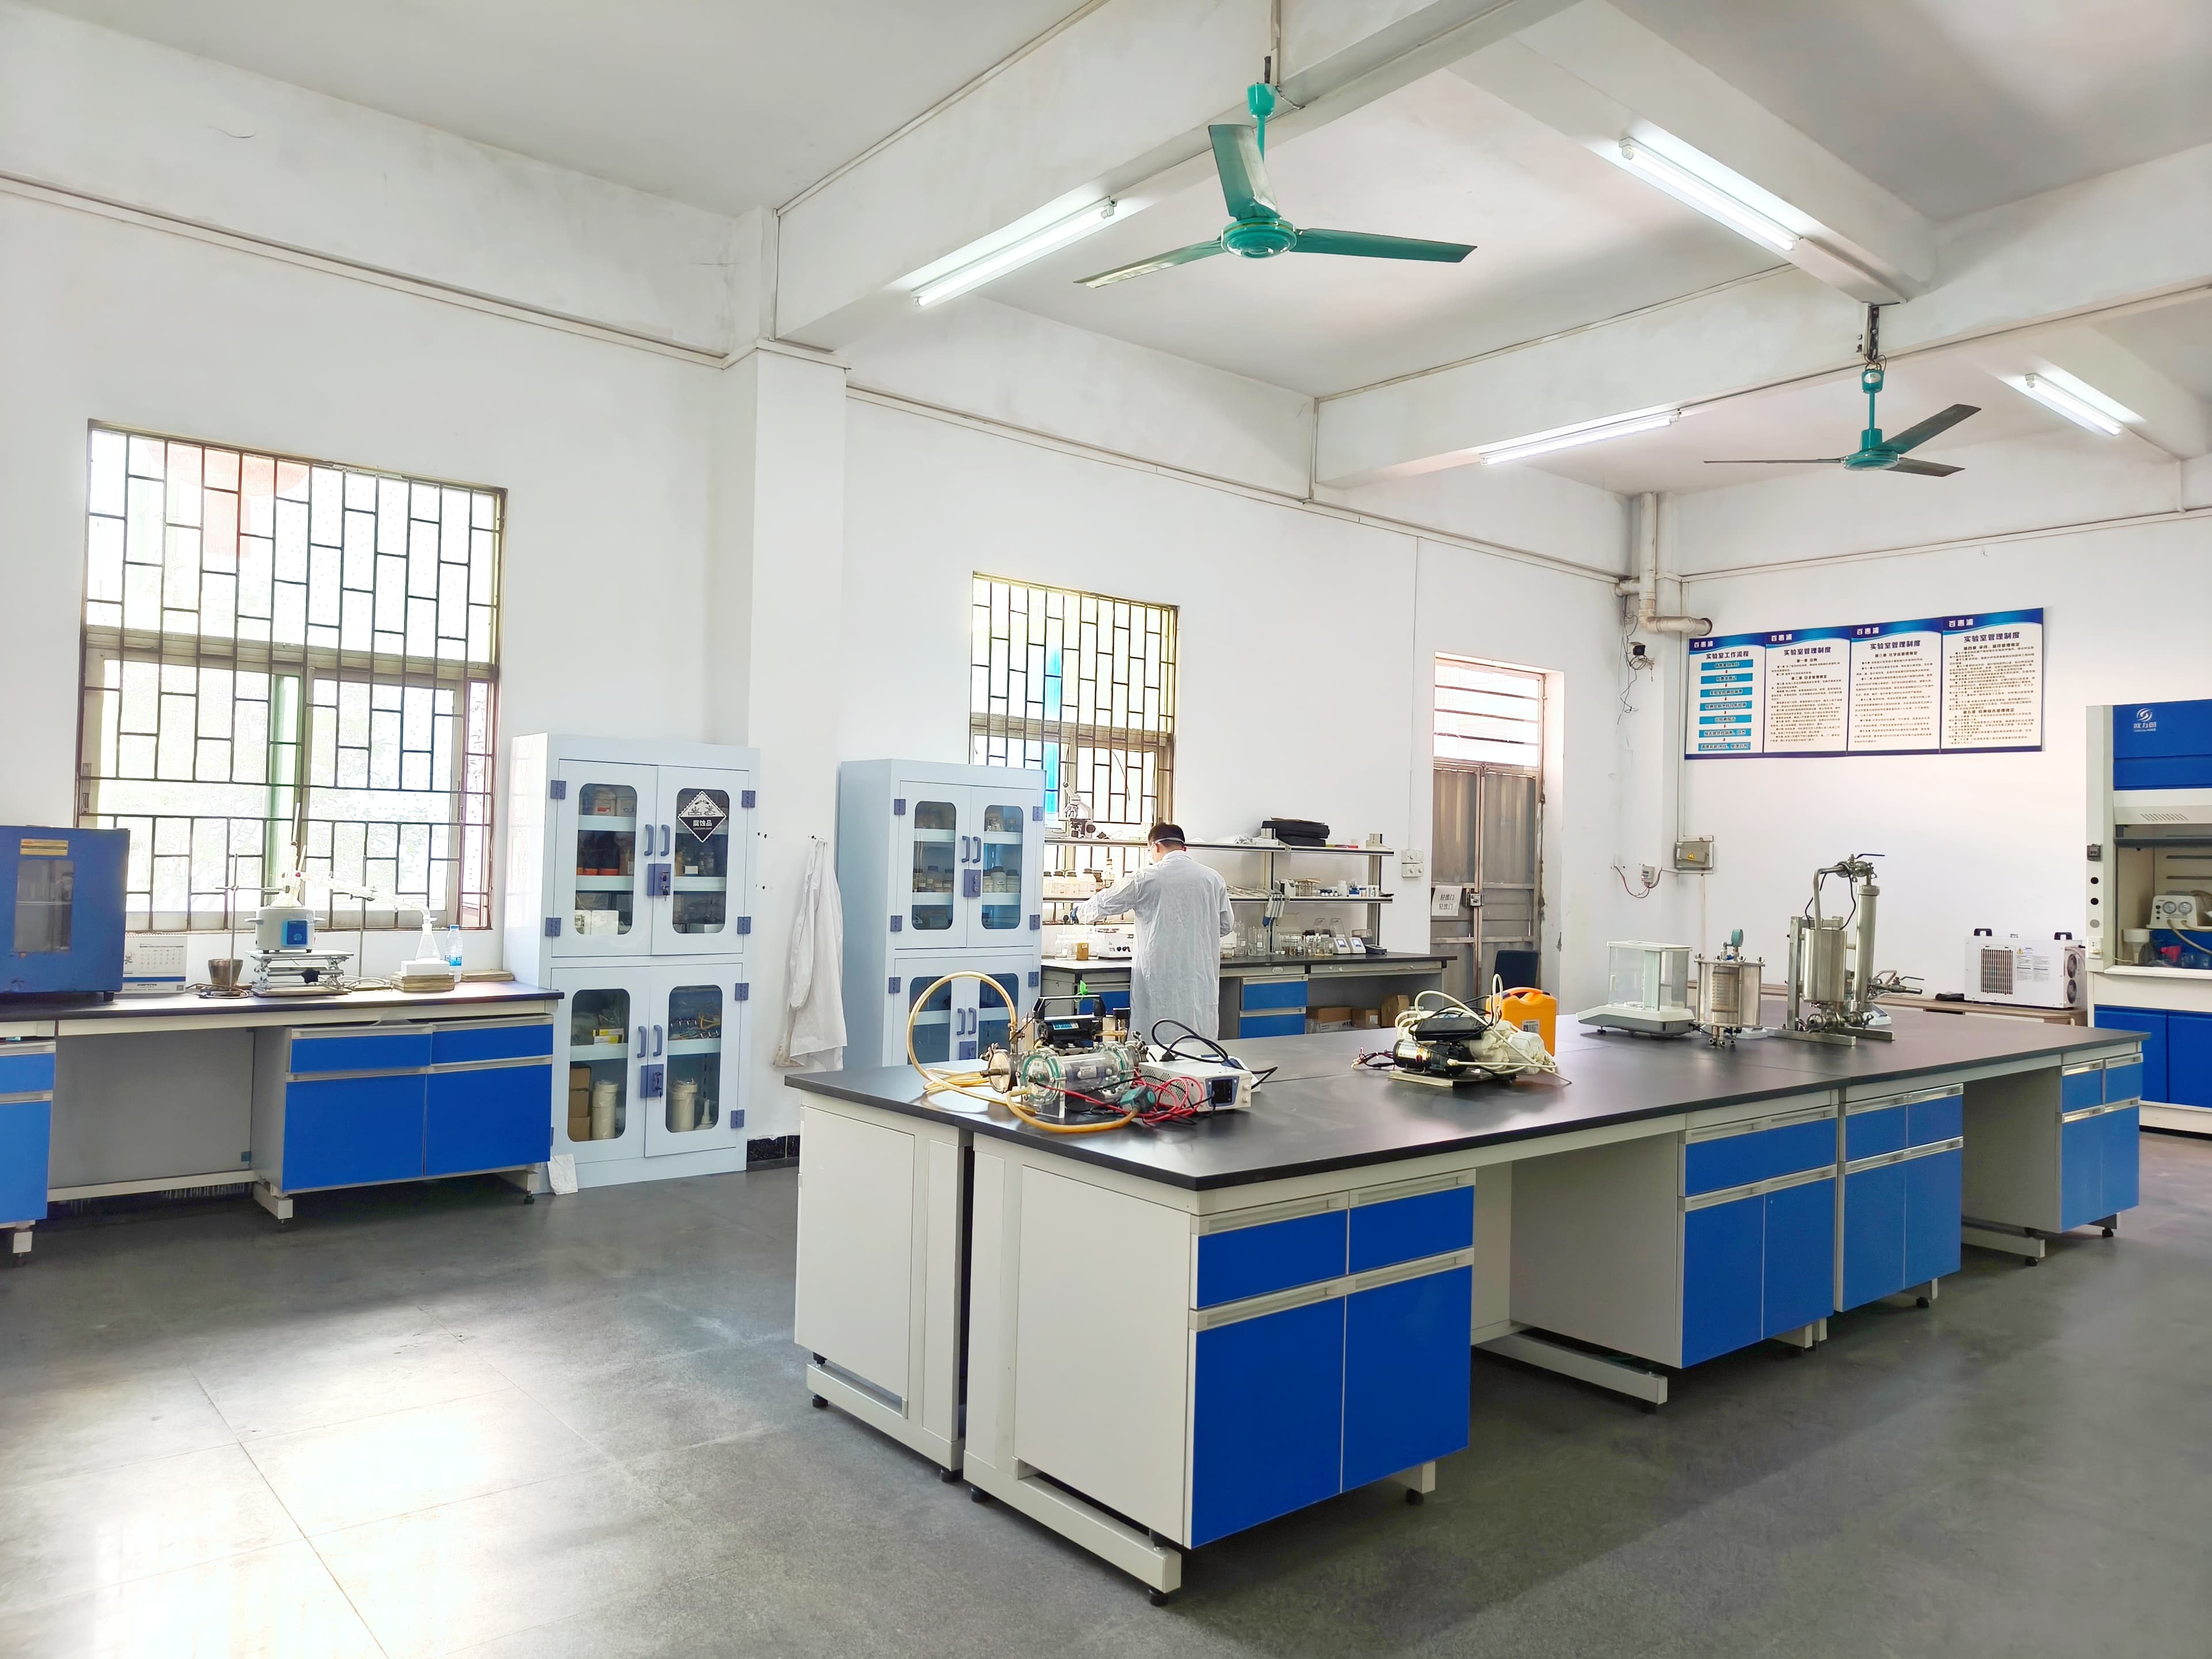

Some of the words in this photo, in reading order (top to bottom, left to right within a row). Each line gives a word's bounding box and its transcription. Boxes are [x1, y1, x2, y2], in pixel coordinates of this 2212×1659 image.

[1964, 631, 2020, 643] 实验室管理制度
[1870, 640, 1921, 650] 实验室管理制度
[1706, 650, 1749, 660] 实验室工作流程
[1783, 646, 1831, 656] 实验室管理制度
